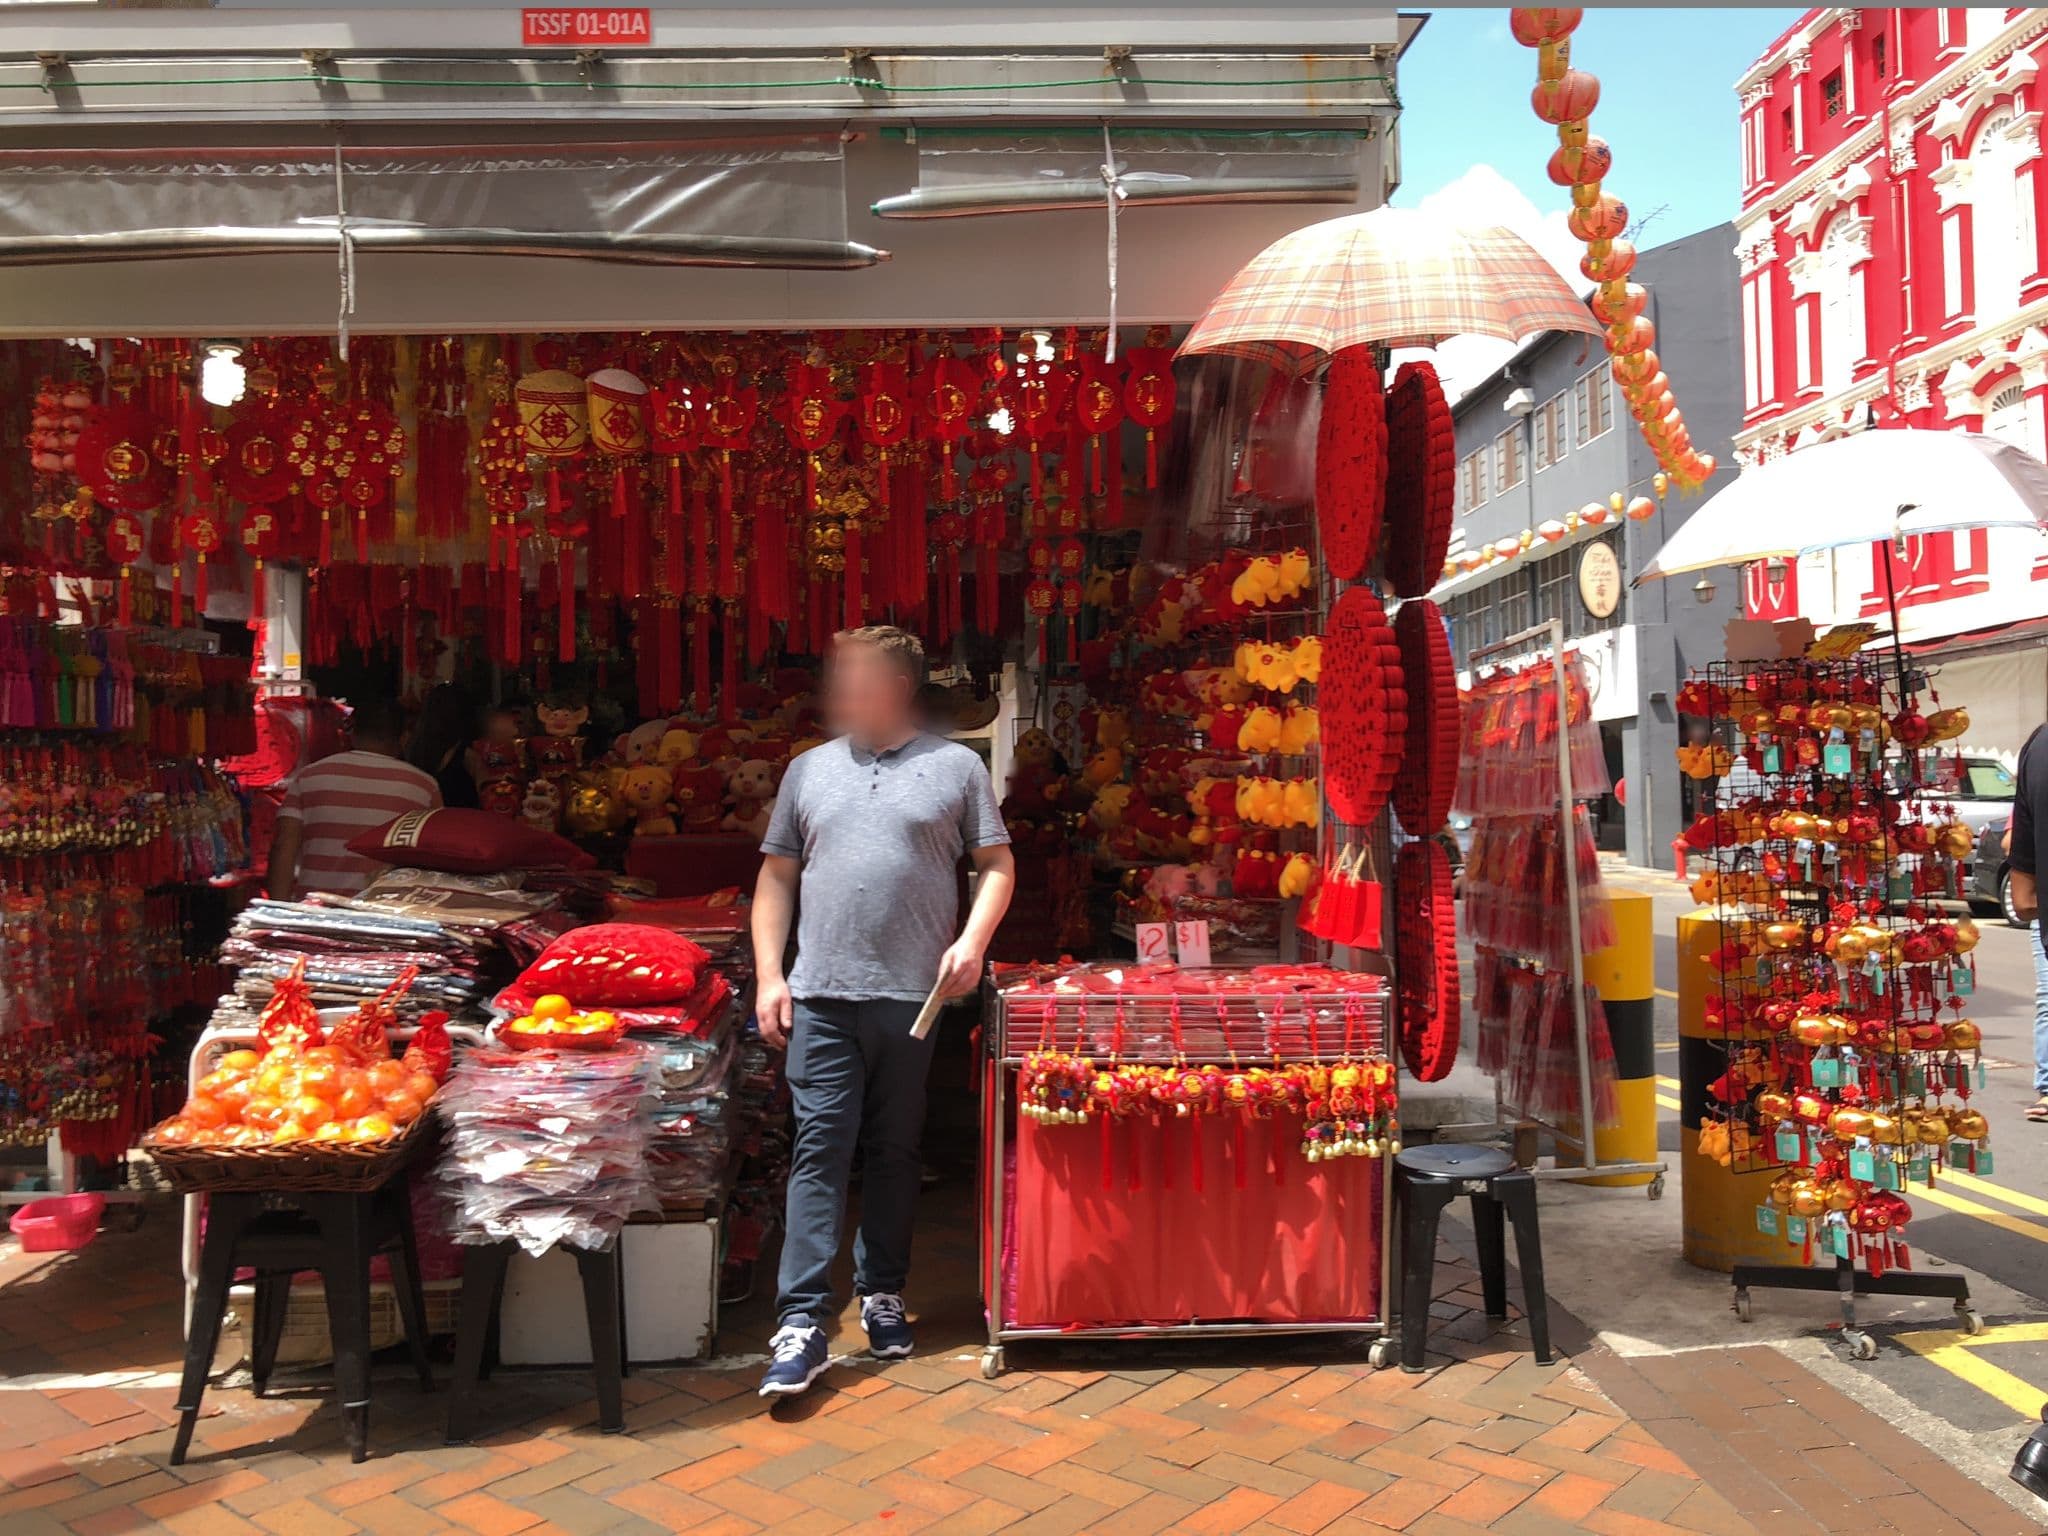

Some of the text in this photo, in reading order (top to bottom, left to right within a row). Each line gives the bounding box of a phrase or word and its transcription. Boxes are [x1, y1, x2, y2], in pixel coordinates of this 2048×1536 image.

[525, 12, 648, 36] TSSF 01-01A
[1140, 927, 1168, 958] $2
[1179, 922, 1200, 949] $1
